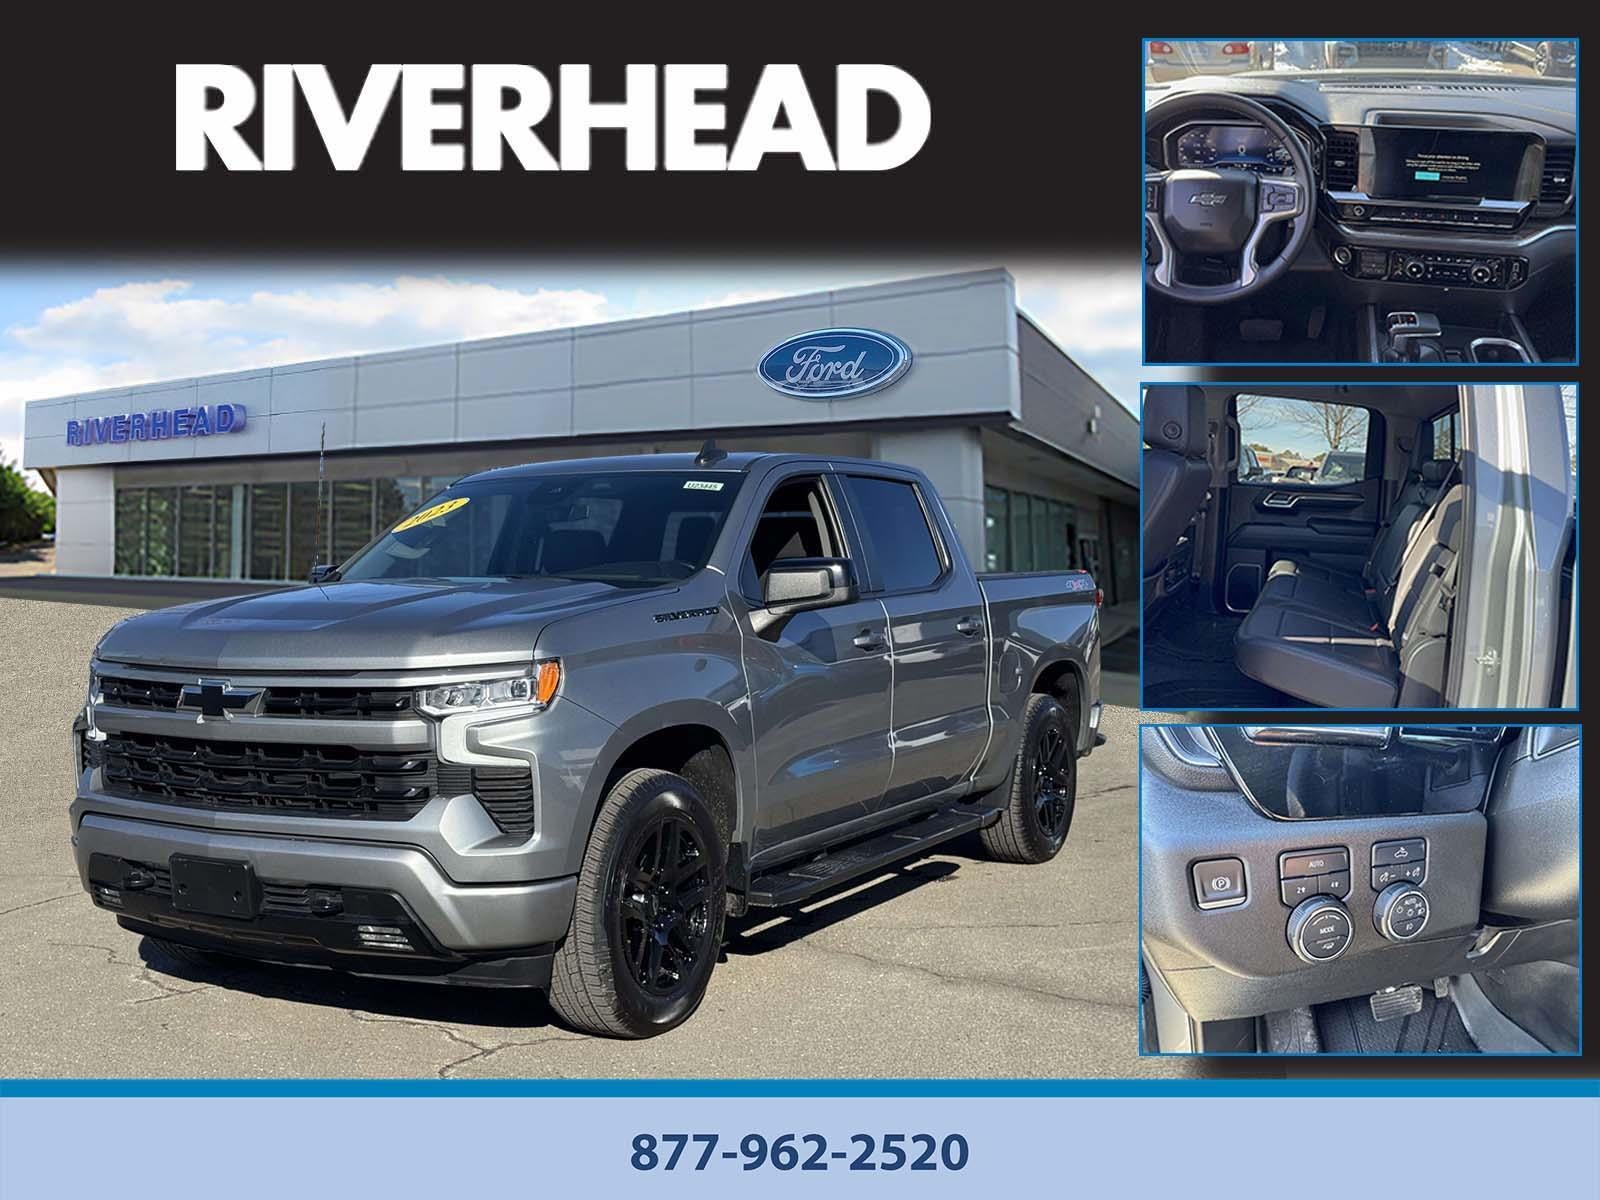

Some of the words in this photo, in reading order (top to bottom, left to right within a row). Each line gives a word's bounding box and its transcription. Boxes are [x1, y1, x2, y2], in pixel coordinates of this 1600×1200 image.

[785, 344, 867, 384] Ford
[66, 404, 241, 447] RIVERHEAD
[1308, 859, 1325, 869] AUTO
[1320, 925, 1335, 935] MODE
